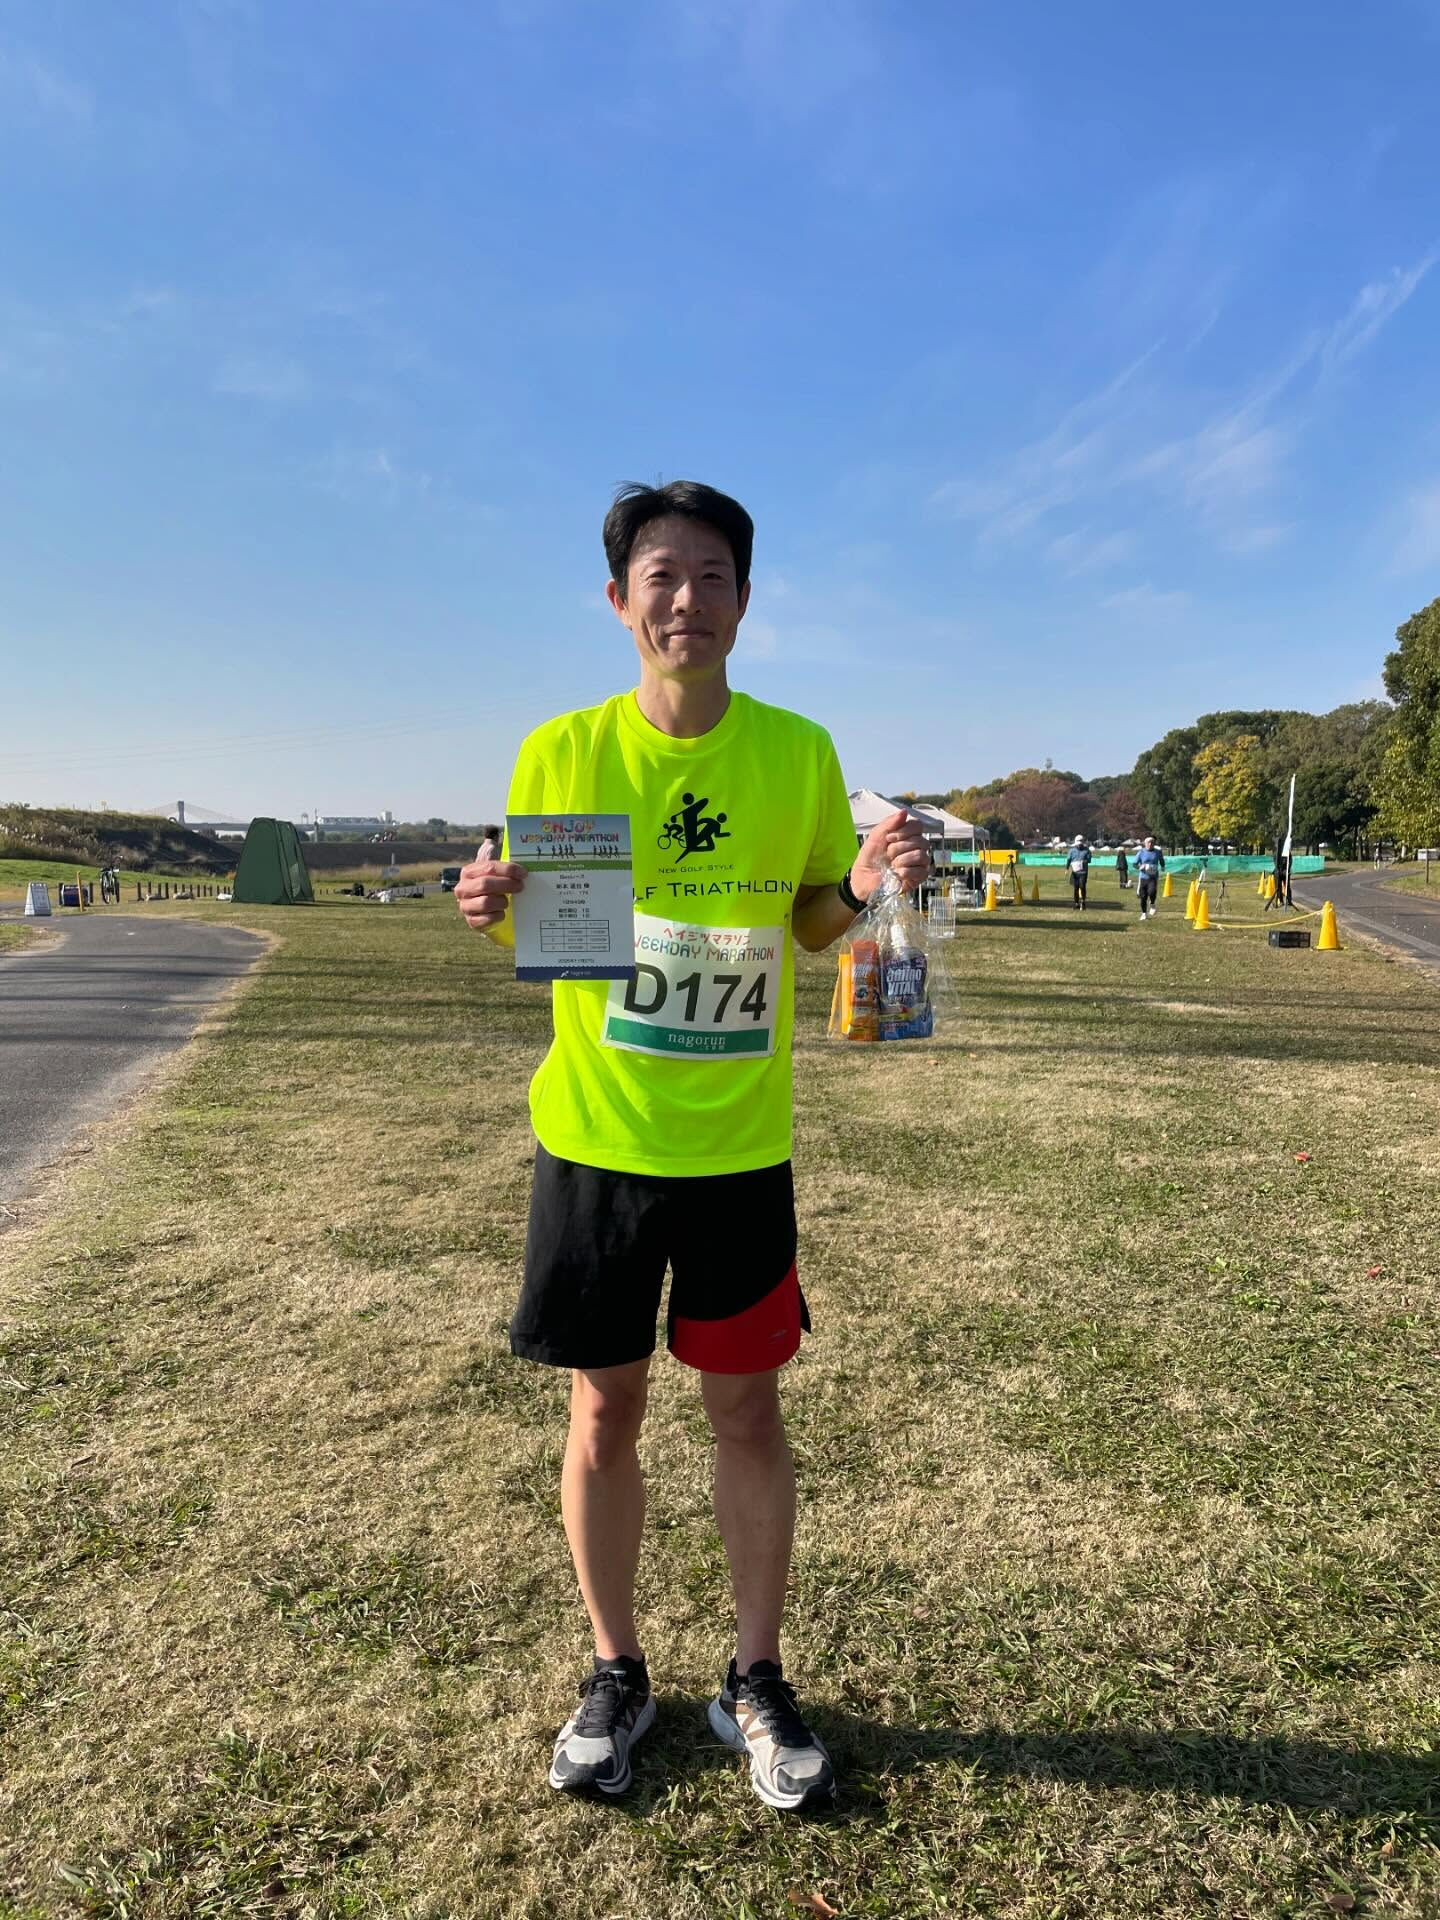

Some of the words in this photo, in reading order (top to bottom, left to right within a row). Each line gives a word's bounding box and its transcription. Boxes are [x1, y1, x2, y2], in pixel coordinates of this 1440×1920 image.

[568, 833, 620, 843] MARATHON
[667, 880, 793, 897] TRIATHLON
[663, 927, 751, 947] ヘイジツマラソン
[706, 947, 775, 961] MARATHON
[623, 962, 767, 1023] D174
[668, 1033, 726, 1048] nagorun
